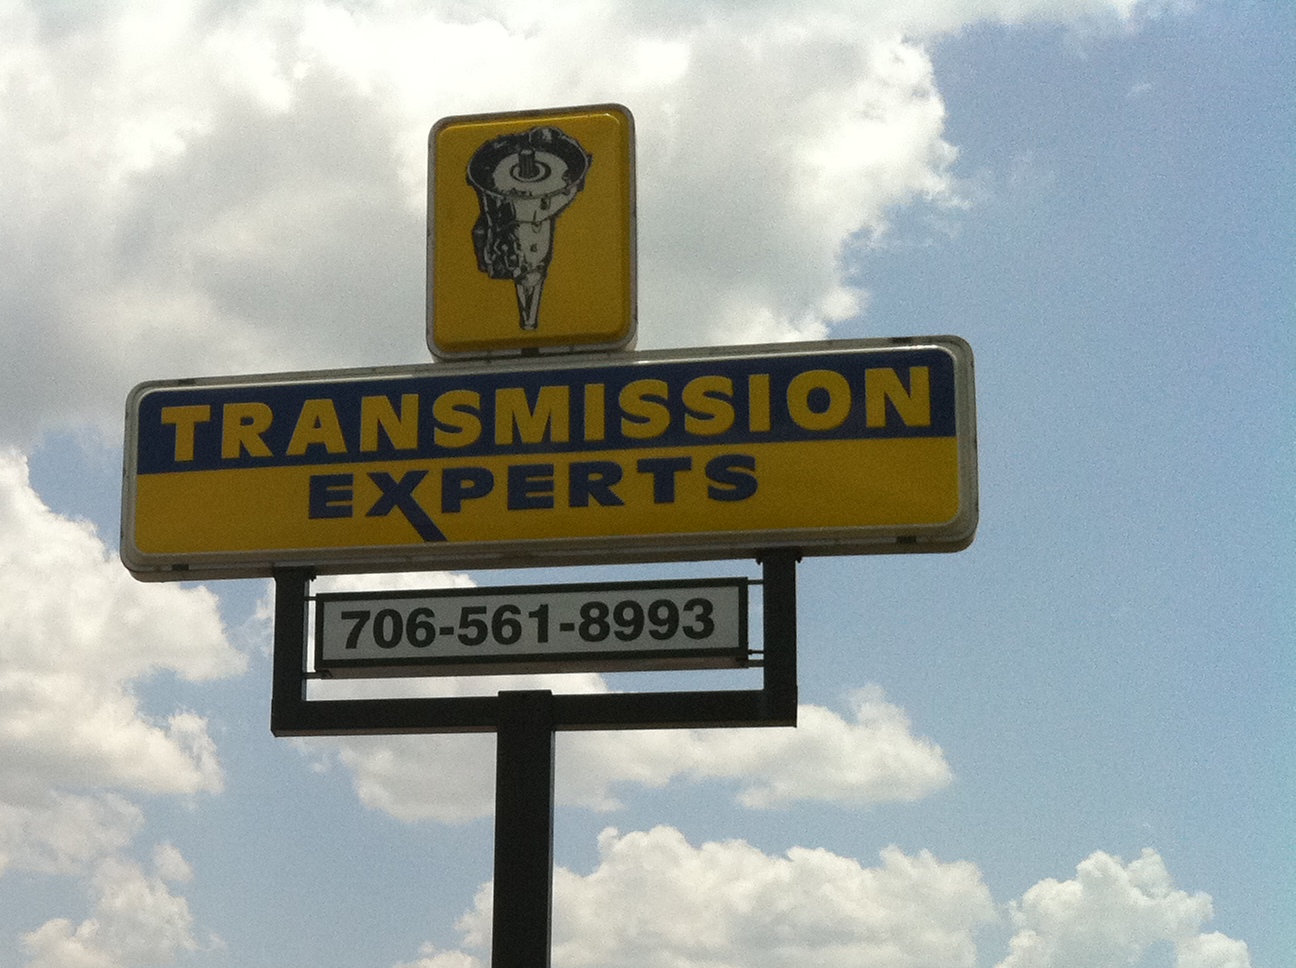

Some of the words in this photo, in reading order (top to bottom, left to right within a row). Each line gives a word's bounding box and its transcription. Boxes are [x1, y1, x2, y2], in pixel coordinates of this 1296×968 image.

[160, 365, 932, 463] TRANSMISSION
[307, 454, 759, 542] EXPERTS
[340, 598, 716, 650] 706-561-8993
